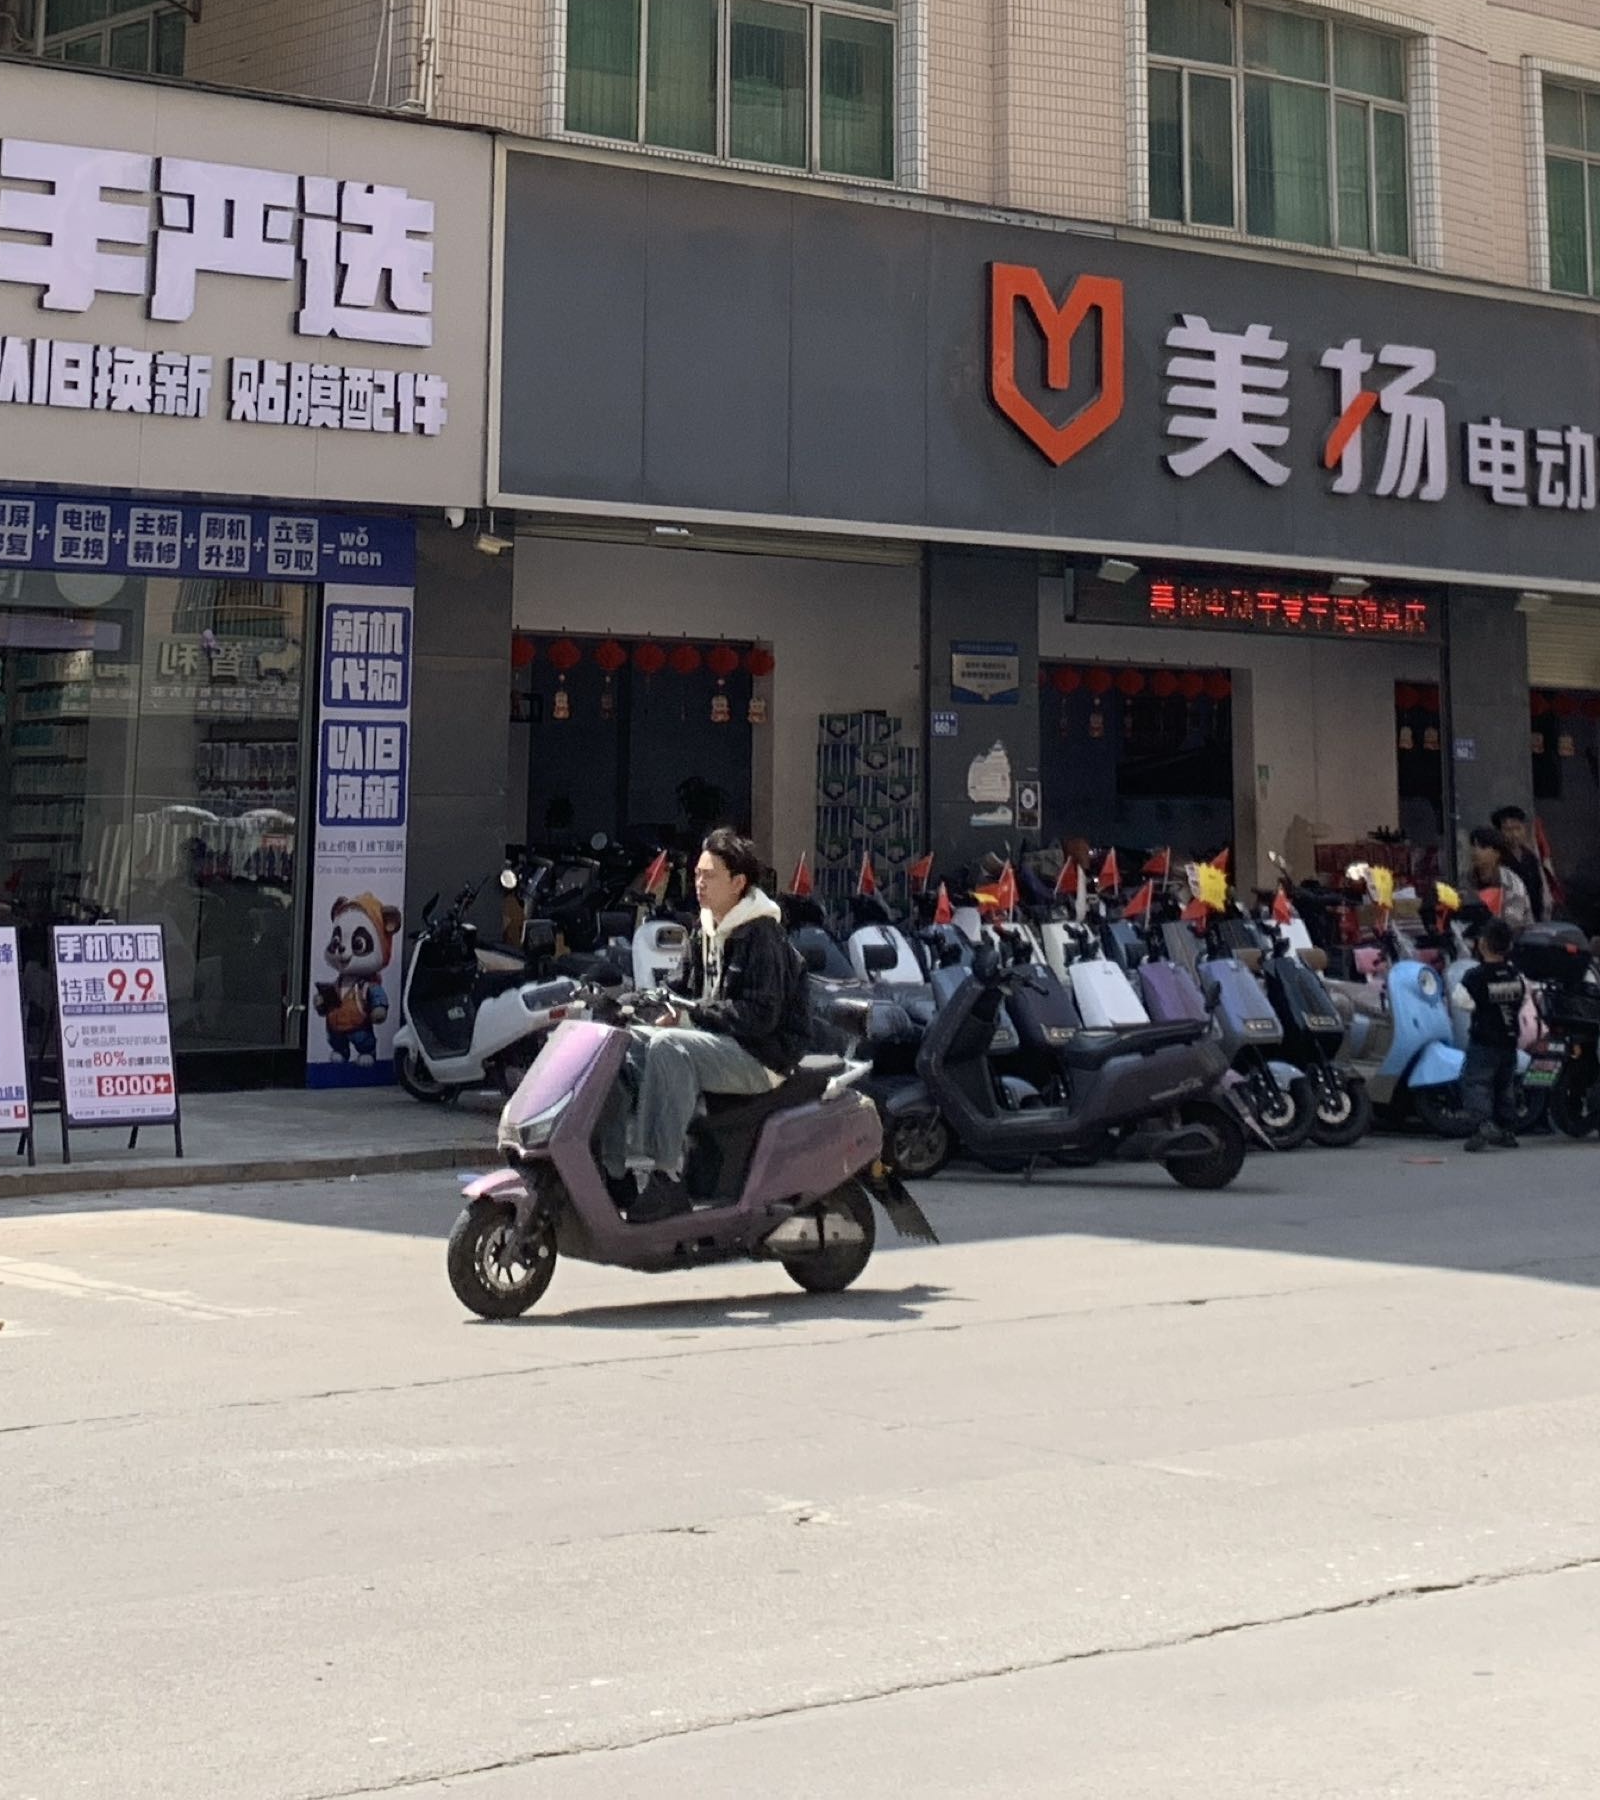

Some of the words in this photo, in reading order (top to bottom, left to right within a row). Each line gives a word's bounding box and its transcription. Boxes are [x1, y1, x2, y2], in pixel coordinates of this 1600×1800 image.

[228, 356, 450, 437] 贴膜配件
[1165, 313, 1448, 501] 美扬
[61, 507, 107, 533] 电池
[134, 511, 178, 537] 主板
[205, 515, 248, 541] 刷机
[273, 519, 315, 545] 立等
[59, 533, 106, 560] 更换
[133, 538, 177, 564] 精修
[204, 541, 247, 568] 升级
[273, 546, 314, 572] 可取
[338, 545, 382, 568] men
[331, 610, 404, 655] 新机
[330, 656, 403, 702] 代购
[327, 726, 400, 770] 以旧
[326, 774, 400, 819] 换新
[57, 933, 161, 962] 手机贴膜
[61, 977, 106, 1003] 特惠
[107, 968, 154, 1002] 9.9
[100, 1075, 169, 1097] 8000+
